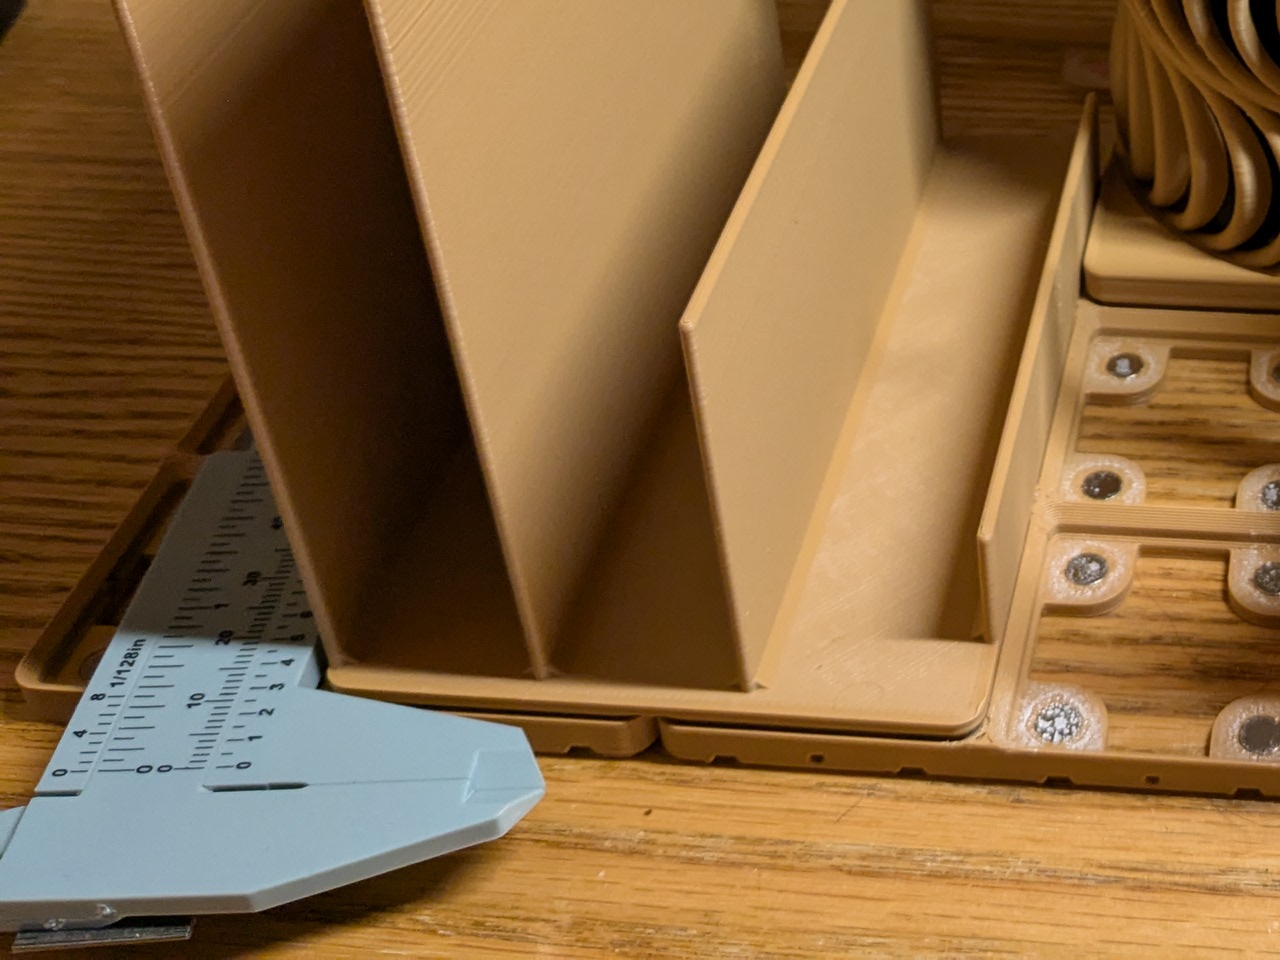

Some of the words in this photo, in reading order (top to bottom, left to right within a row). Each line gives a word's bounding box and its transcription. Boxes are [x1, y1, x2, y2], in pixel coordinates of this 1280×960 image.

[215, 630, 234, 647] 20
[110, 638, 147, 688] 1/128in
[280, 658, 296, 667] 4
[269, 682, 285, 692] 3
[90, 692, 107, 702] 8
[187, 693, 206, 710] 10
[258, 707, 276, 717] 2
[73, 728, 88, 739] 4
[248, 734, 264, 742] 1
[136, 765, 153, 775] 0
[157, 765, 173, 774] 0
[235, 761, 252, 770] 0
[51, 768, 68, 778] 0
